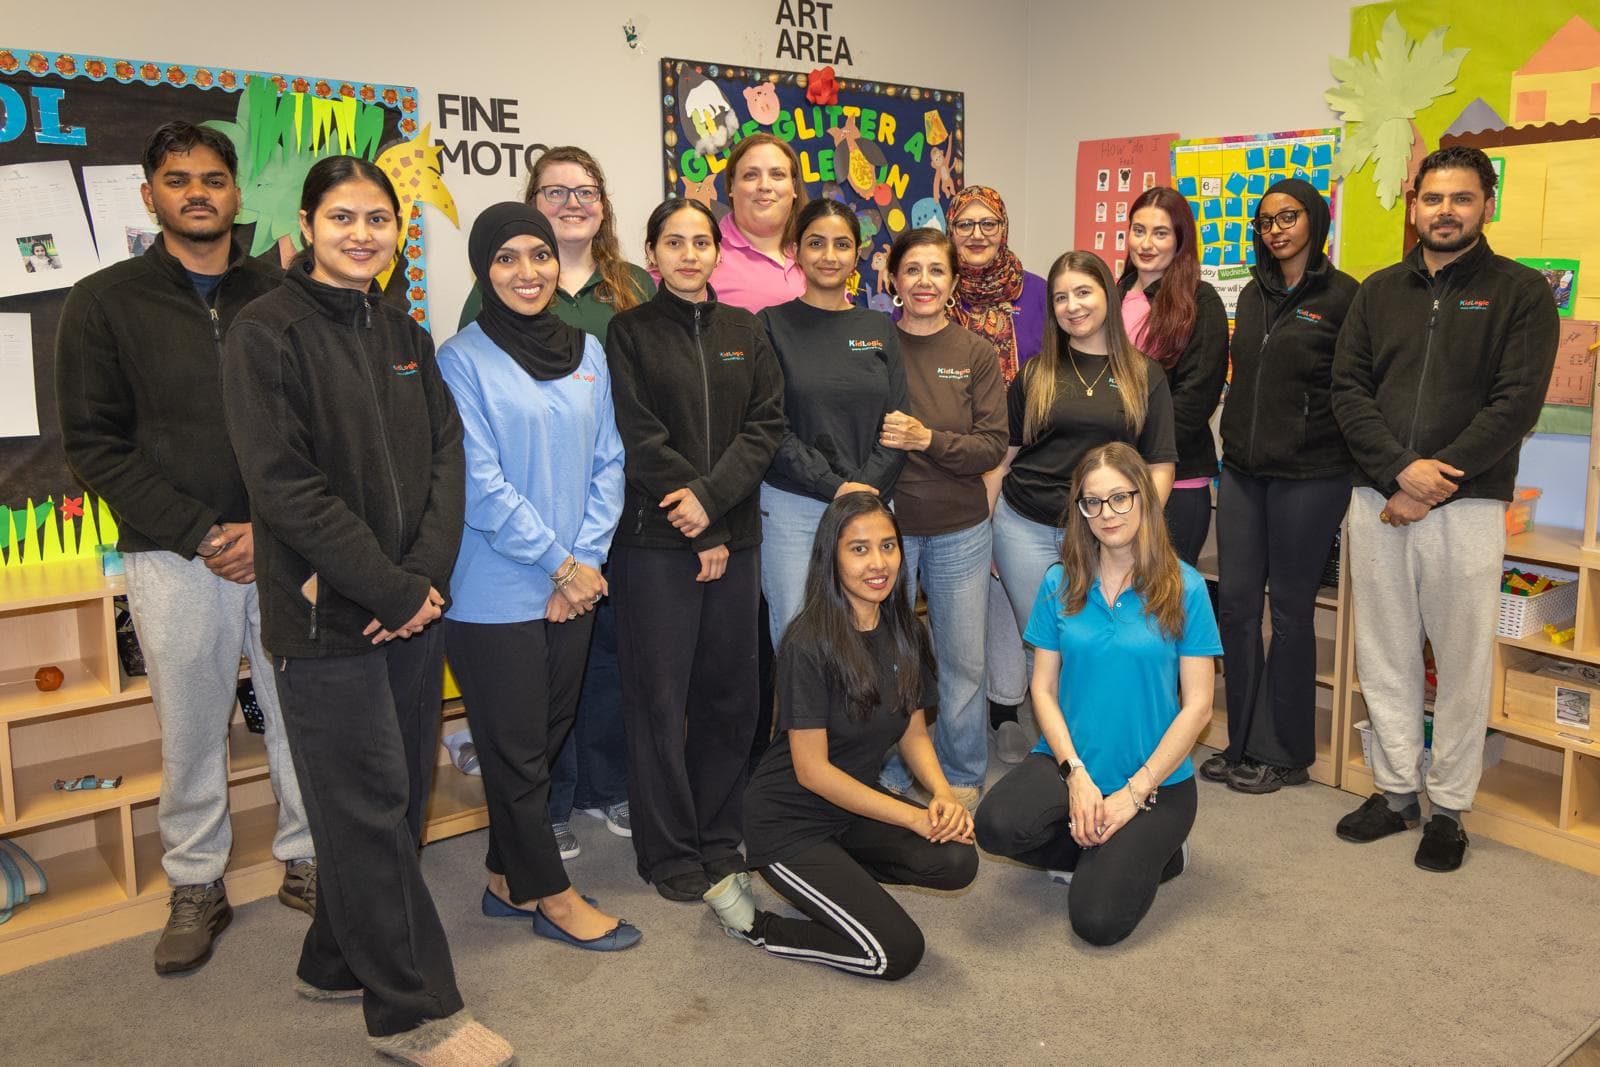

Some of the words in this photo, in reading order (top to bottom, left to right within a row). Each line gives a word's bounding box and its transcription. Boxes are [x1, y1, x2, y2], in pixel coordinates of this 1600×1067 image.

[775, 0, 833, 31] ART
[776, 29, 853, 66] AREA
[437, 93, 520, 134] FINE
[772, 106, 897, 146] GLITTER
[1227, 284, 1238, 292] will
[848, 339, 883, 347] KidLogic
[936, 367, 971, 376] KidLogic
